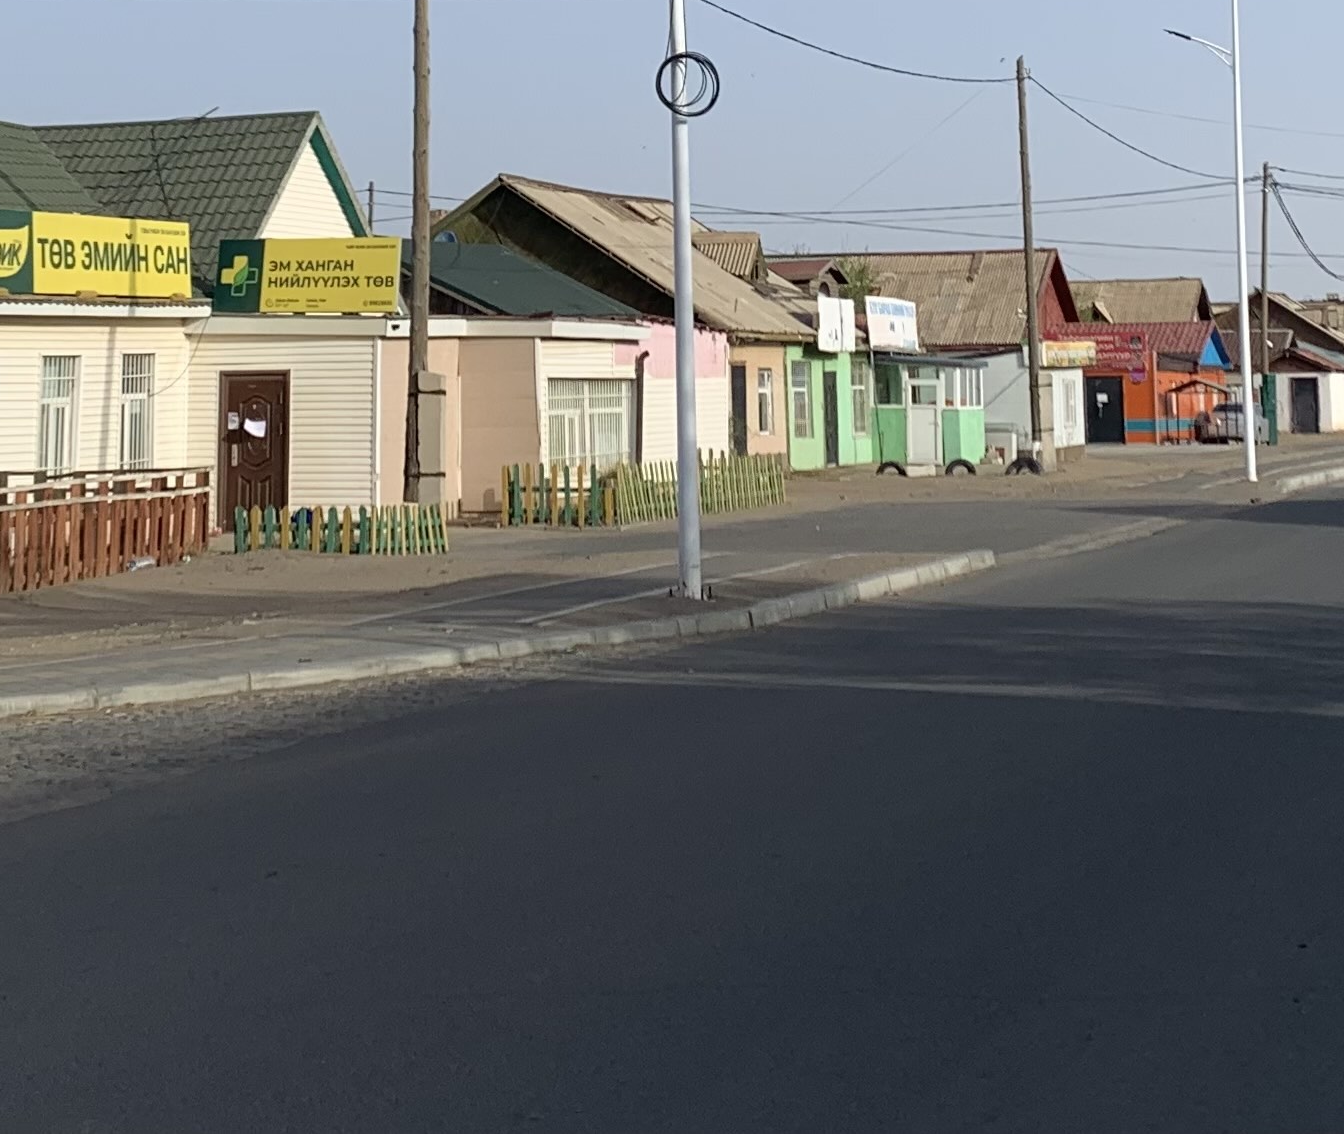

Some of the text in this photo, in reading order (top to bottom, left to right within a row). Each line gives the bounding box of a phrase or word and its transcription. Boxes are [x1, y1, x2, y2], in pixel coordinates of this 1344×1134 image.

[37, 233, 189, 275] ТӨВ ЭМИЙН САН
[268, 260, 355, 272] ЭМ ХАНГАН
[267, 274, 395, 288] НИЙЛҮҮЛЭХ ТӨВ
